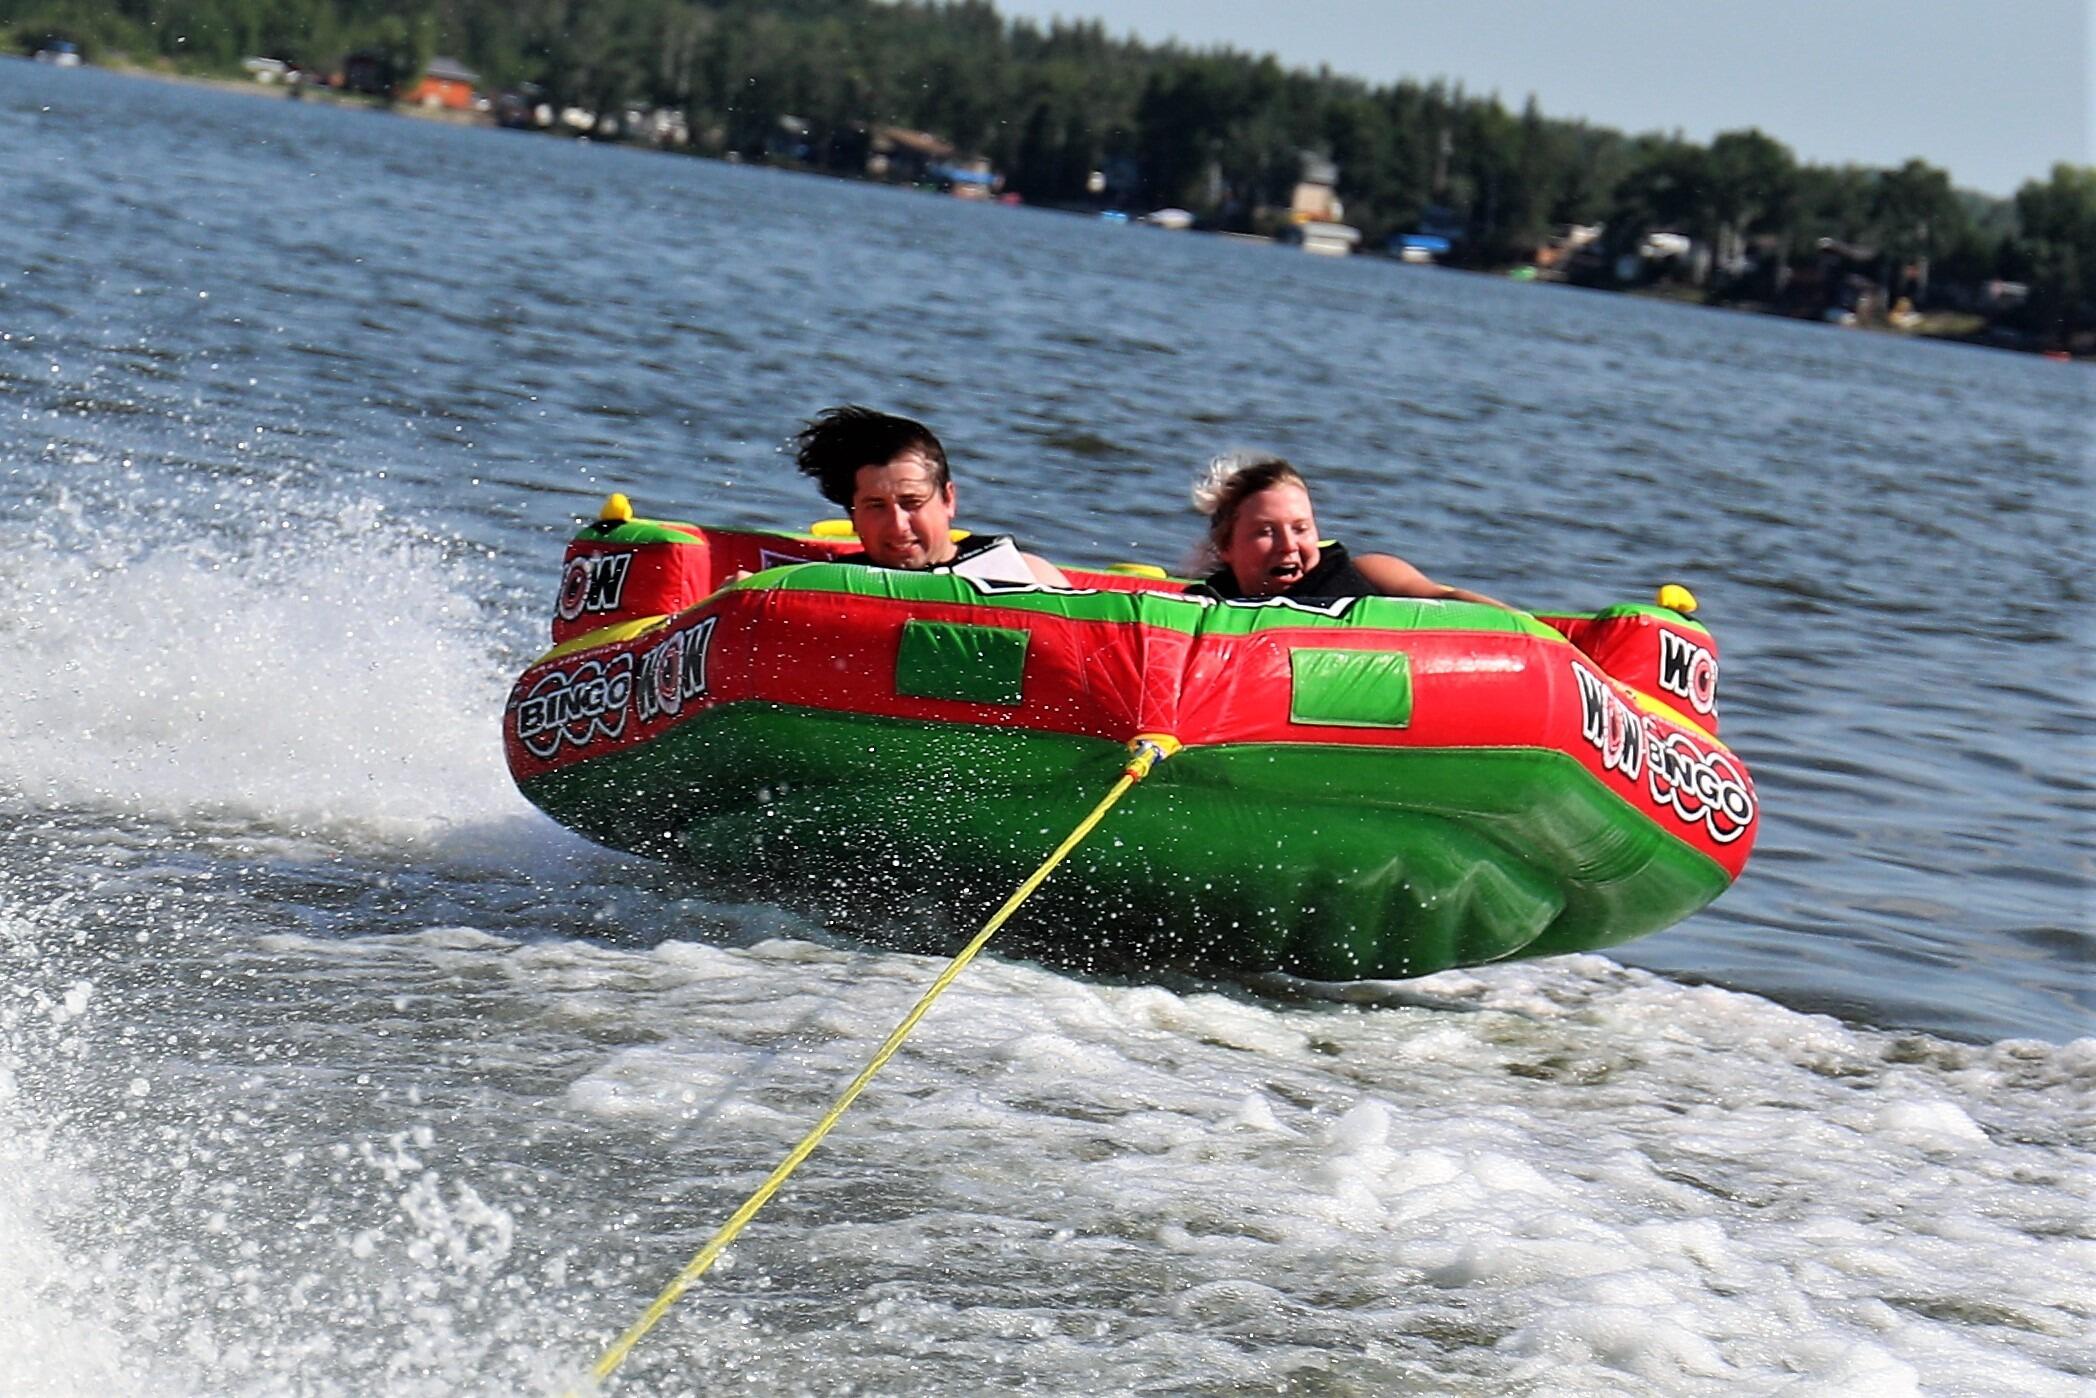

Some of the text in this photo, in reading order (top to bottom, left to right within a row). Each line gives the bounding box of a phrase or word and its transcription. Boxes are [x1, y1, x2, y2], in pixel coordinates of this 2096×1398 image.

[556, 553, 632, 620] OW
[517, 616, 717, 739] BINGO WOW
[1658, 628, 1718, 717] WO
[1571, 660, 1754, 827] WOW BINGO
